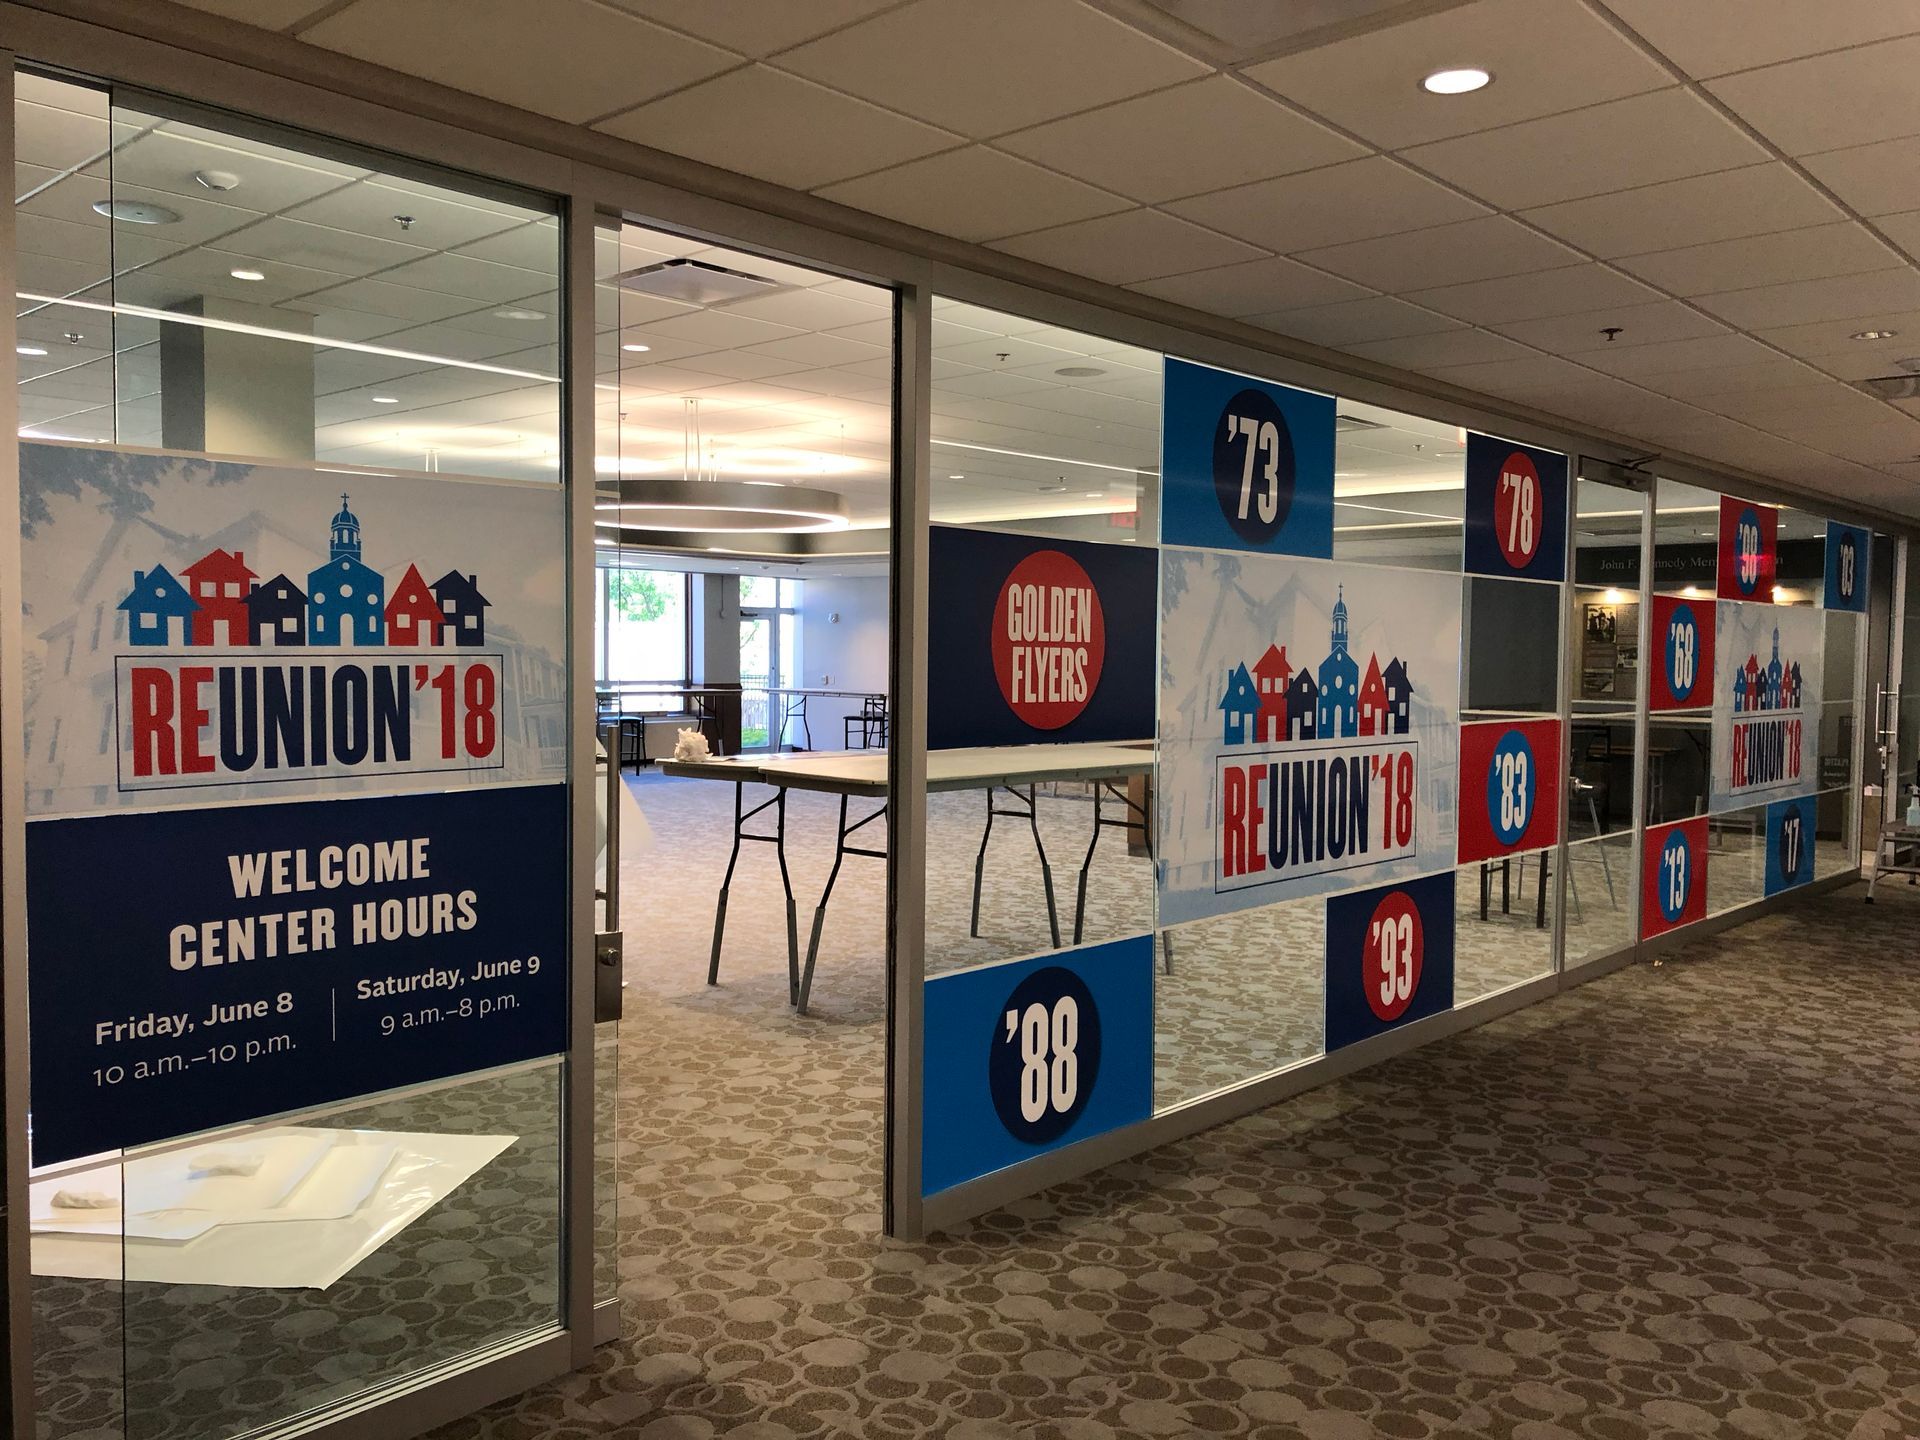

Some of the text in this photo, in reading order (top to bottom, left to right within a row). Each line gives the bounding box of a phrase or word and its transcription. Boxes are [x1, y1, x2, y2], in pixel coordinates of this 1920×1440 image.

[1227, 414, 1279, 525] '73
[1503, 472, 1535, 556] '78
[1600, 558, 1625, 570] John
[1654, 556, 1687, 571] nnedy
[1007, 582, 1092, 644] GOLDEN
[1011, 646, 1089, 704] FLYERS
[1670, 622, 1694, 690] '68
[130, 662, 497, 778] REUNION'18
[1223, 750, 1414, 878] REUNION'18
[1494, 750, 1529, 833] '83
[227, 836, 432, 899] WELCOME
[1664, 844, 1686, 912] '13
[1783, 817, 1801, 874] '17
[169, 888, 479, 972] CENTER HOURS
[1371, 912, 1414, 1008] '93
[356, 954, 541, 1001] Saturday, June 9
[95, 991, 294, 1046] Friday, June 8
[380, 1015, 395, 1037] 9
[478, 991, 521, 1021] p.m.
[93, 1065, 125, 1088] 10
[245, 1033, 298, 1063] p.m.
[1005, 994, 1079, 1124] '88
